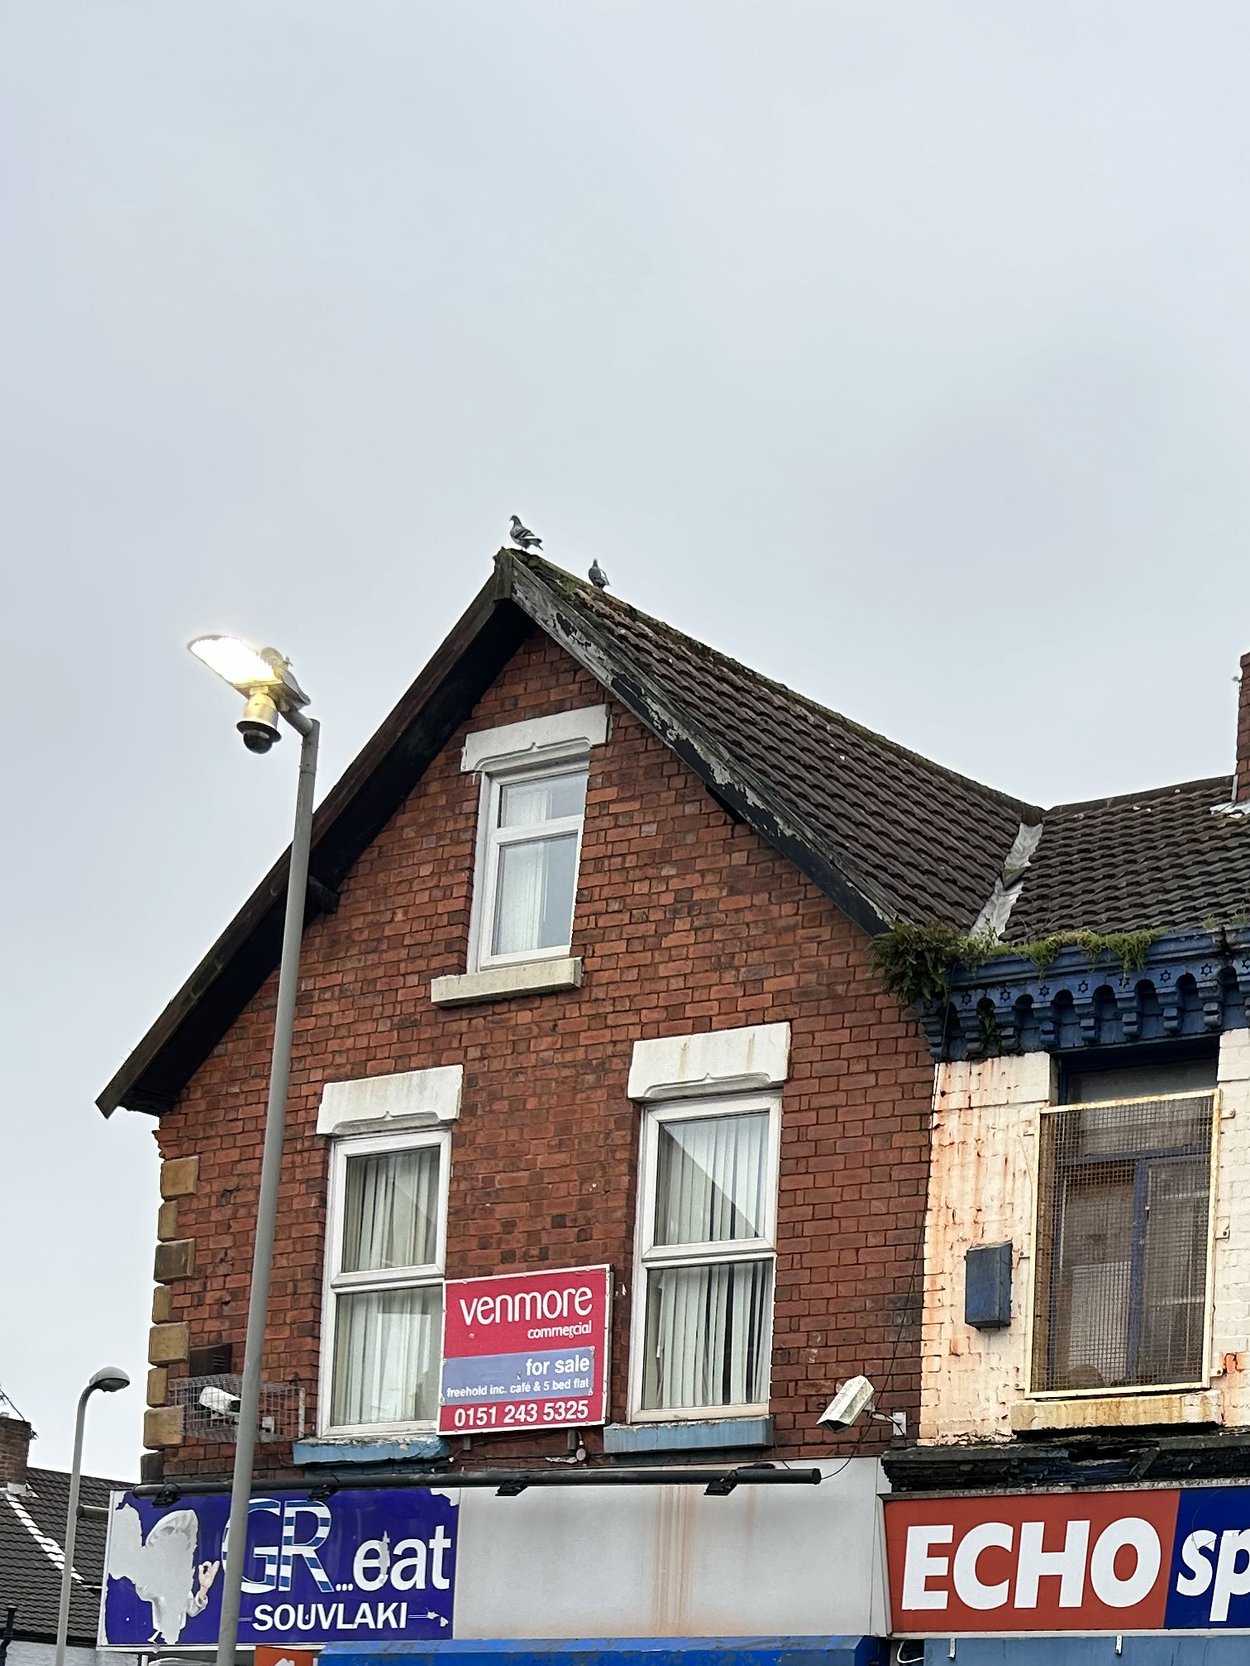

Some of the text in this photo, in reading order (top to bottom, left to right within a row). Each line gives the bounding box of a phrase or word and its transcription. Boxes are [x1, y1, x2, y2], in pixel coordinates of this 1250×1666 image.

[459, 1286, 593, 1326] venmore
[527, 1320, 592, 1340] commercial
[526, 1355, 590, 1376] for sale
[446, 1385, 488, 1398] freehold
[489, 1384, 507, 1395] inc.
[533, 1381, 541, 1391] &
[543, 1381, 549, 1391] 5
[552, 1379, 571, 1390] bed
[573, 1378, 589, 1389] flat
[454, 1400, 588, 1427] 0151 243 5325
[901, 1516, 1162, 1611] ECHO
[252, 1602, 407, 1631] SOUVLAKI
